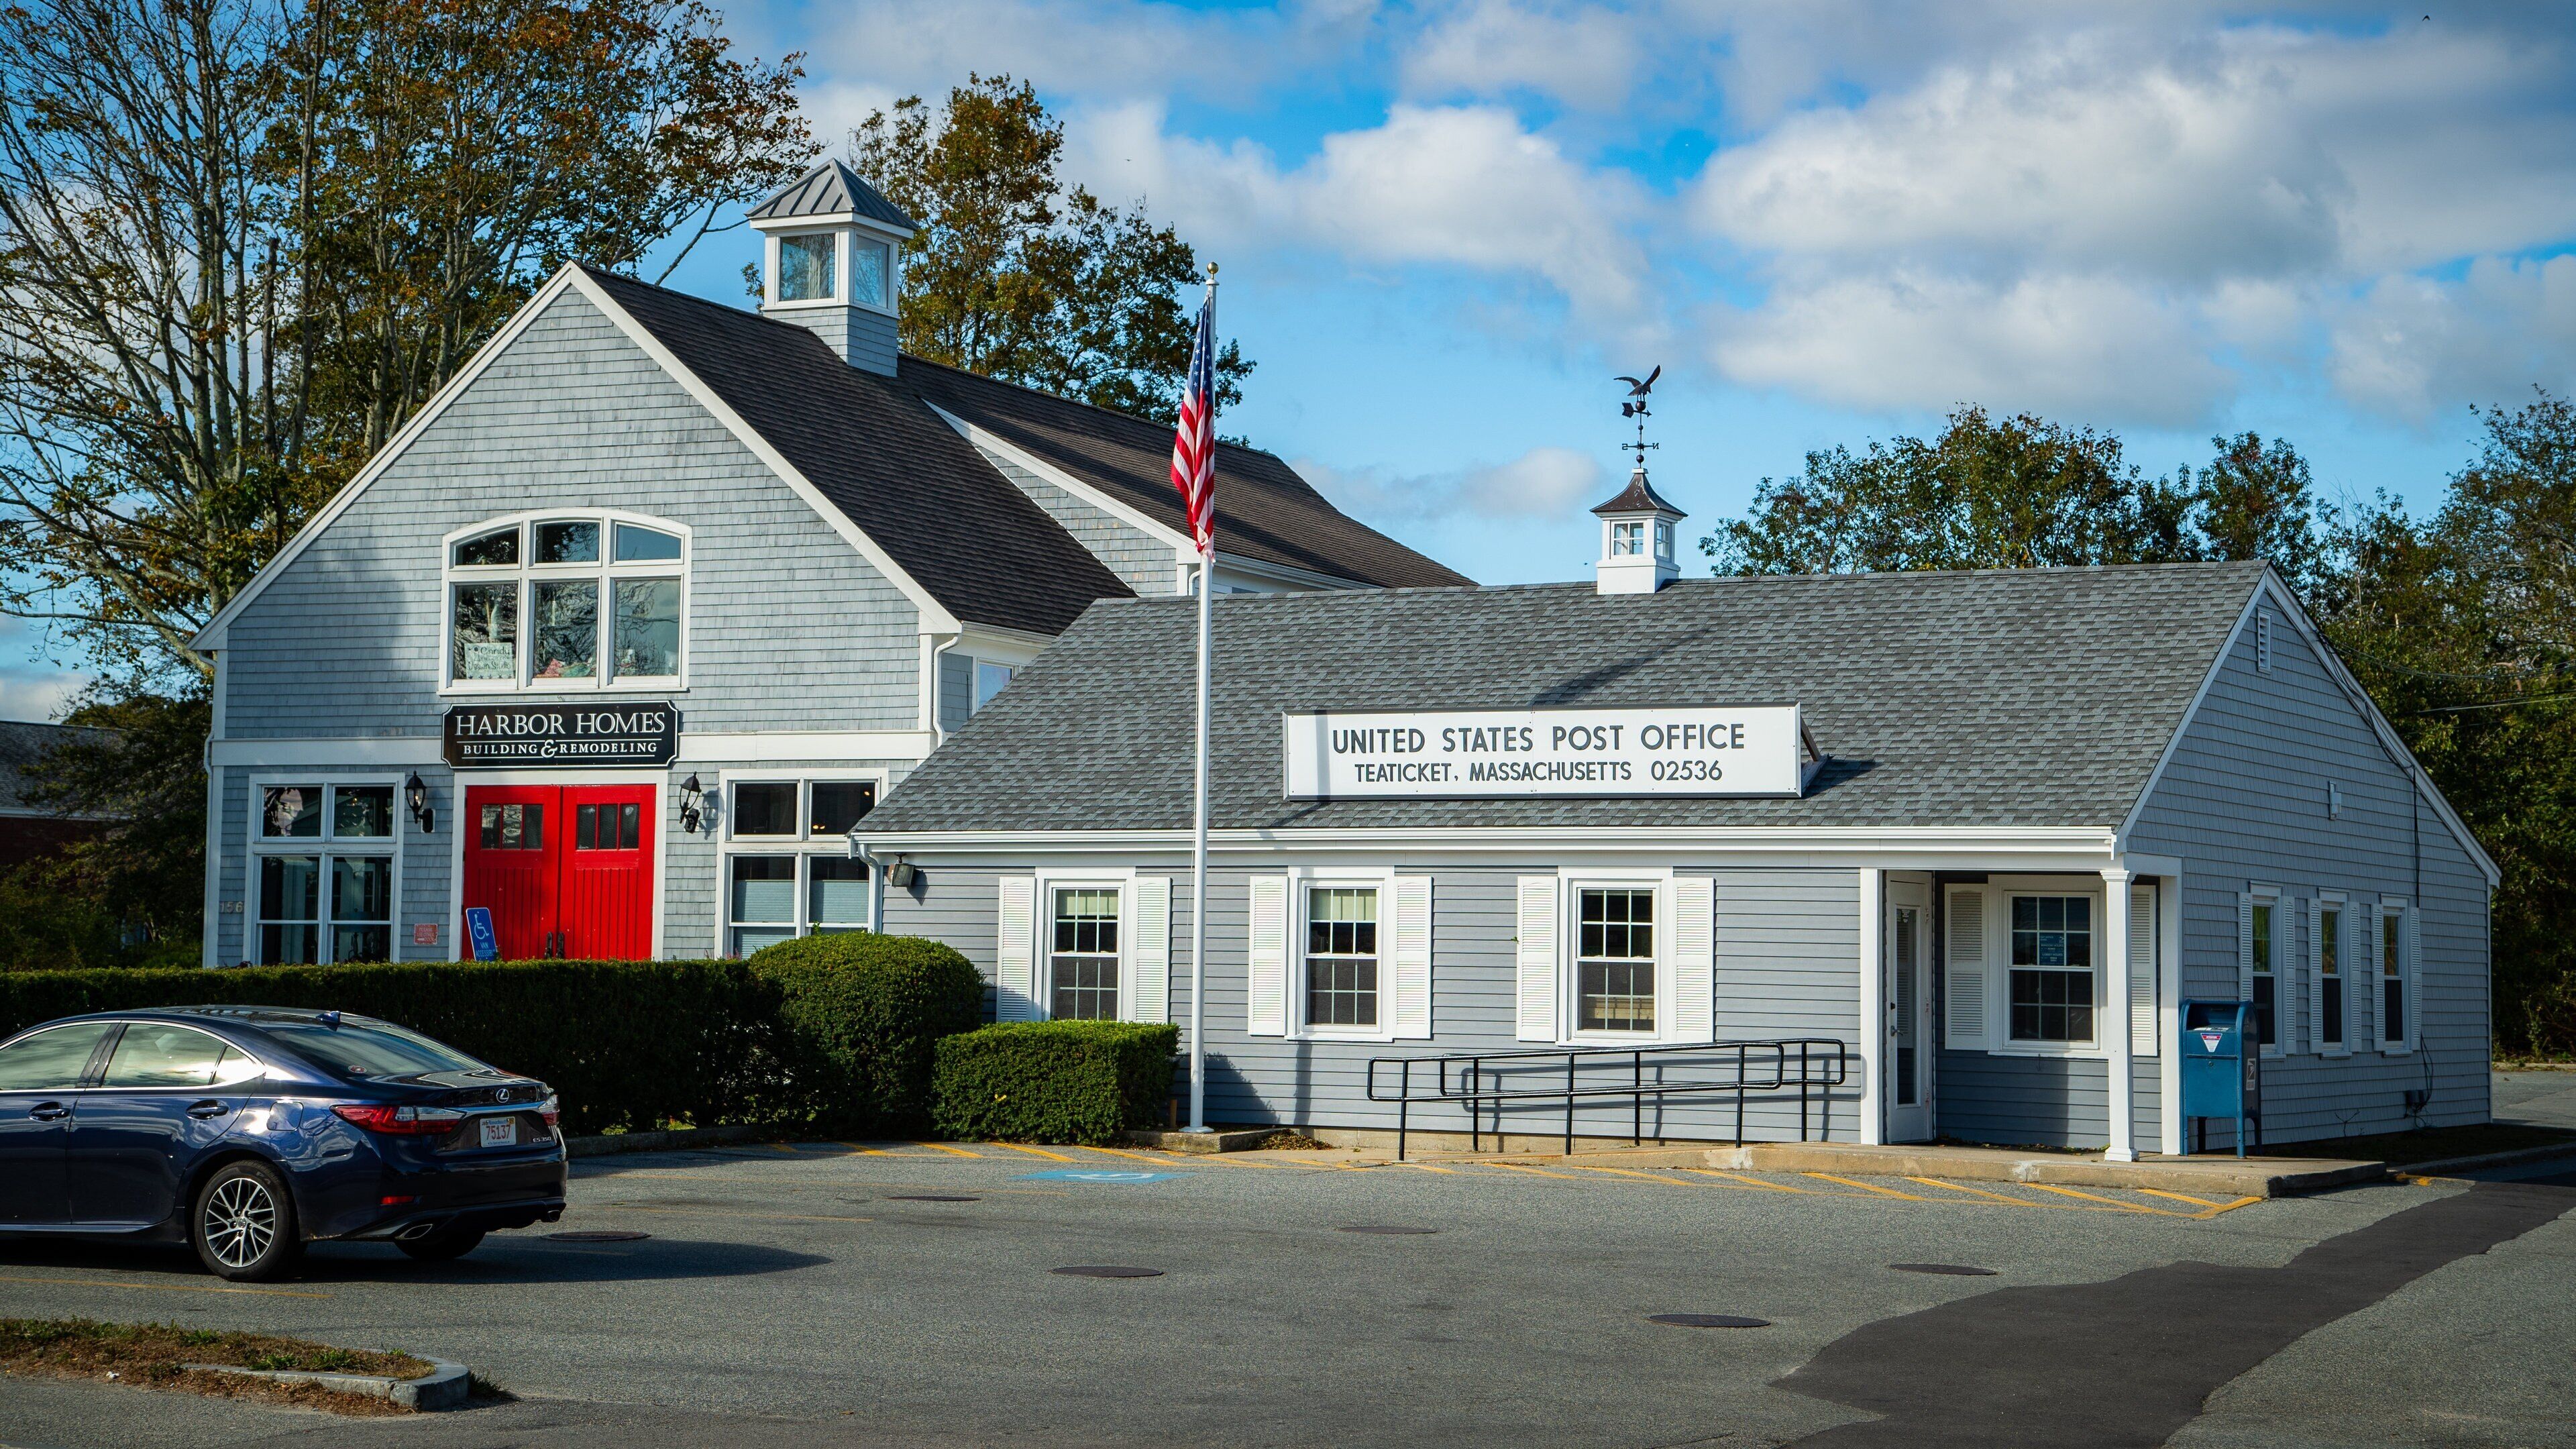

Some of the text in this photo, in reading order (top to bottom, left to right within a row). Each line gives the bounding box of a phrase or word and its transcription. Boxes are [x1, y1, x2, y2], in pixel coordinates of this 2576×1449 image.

[480, 646, 510, 655] Candy
[491, 661, 511, 670] Studio
[455, 712, 665, 735] HARBOR HOMES
[1333, 723, 1744, 754] UNITED STATES POST OFFICE
[464, 739, 657, 758] BUILDING & REMODELING
[1354, 760, 1723, 783] TEATICKET, MASSACHUSETTS 02536
[220, 901, 243, 913] 156
[480, 941, 489, 949] VAN
[486, 1125, 511, 1140] 75137
